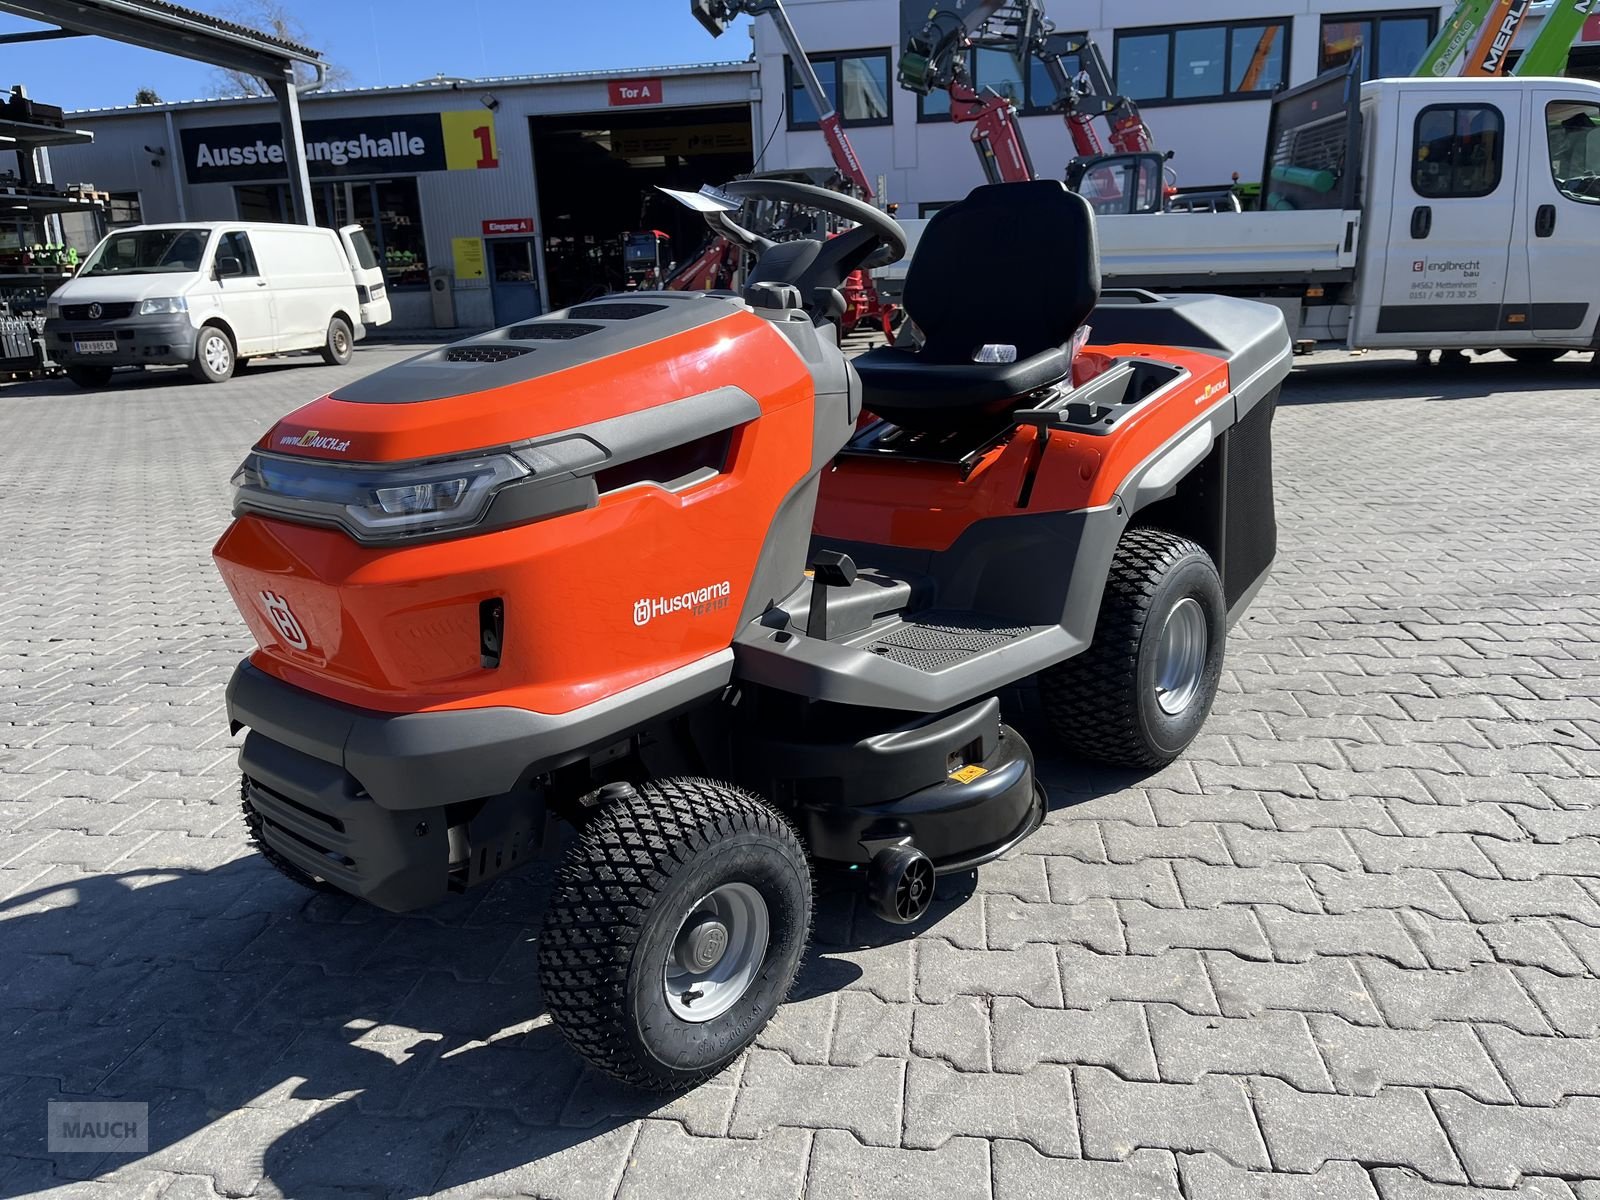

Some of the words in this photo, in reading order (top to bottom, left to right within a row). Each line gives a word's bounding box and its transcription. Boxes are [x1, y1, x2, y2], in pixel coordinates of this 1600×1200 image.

[1443, 20, 1473, 59] MERLO
[1482, 0, 1528, 71] MERL
[619, 87, 639, 99] Tor
[642, 86, 651, 97] A
[473, 126, 498, 169] 1
[489, 223, 519, 231] Eingang
[520, 221, 527, 230] A
[1428, 260, 1480, 272] englbrecht
[652, 580, 730, 618] Husqvarna
